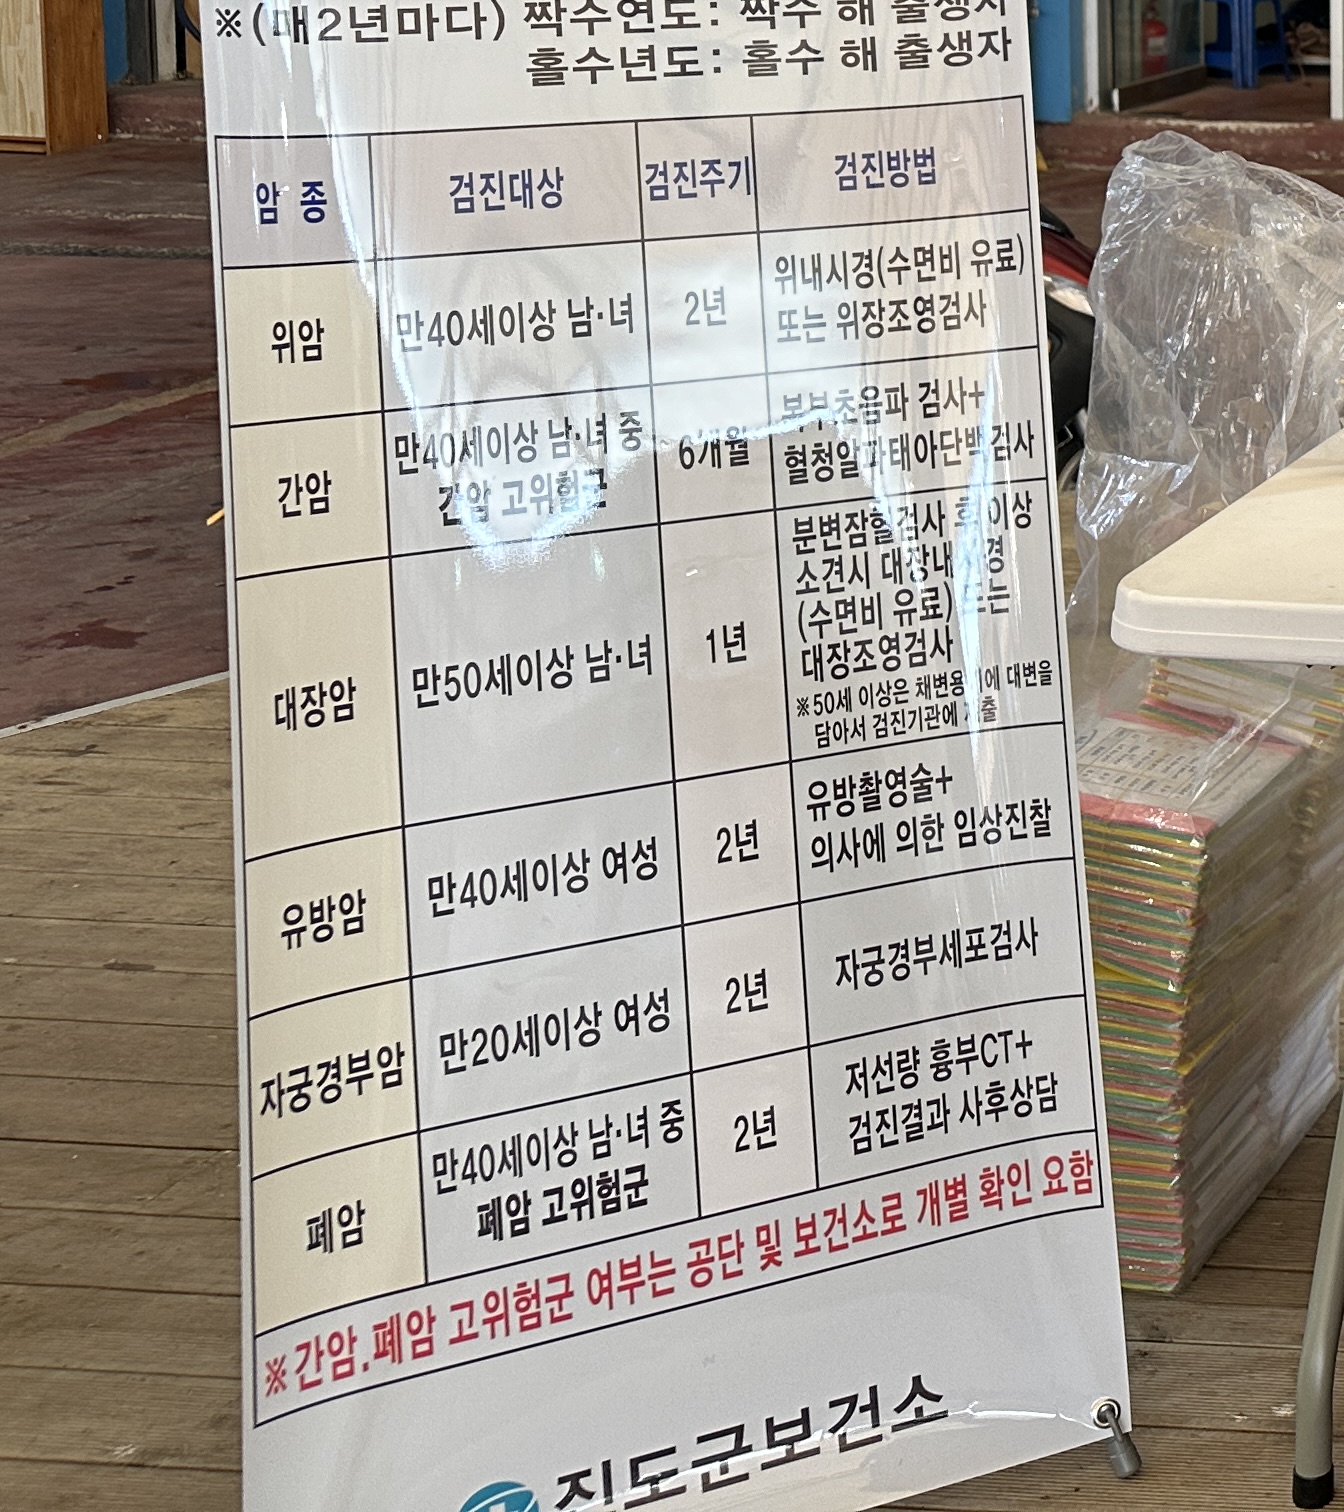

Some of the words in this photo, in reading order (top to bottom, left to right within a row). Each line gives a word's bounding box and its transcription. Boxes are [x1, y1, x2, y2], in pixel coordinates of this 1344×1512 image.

[525, 44, 722, 87] 홀수년도:
[741, 39, 824, 78] 홀수
[839, 34, 879, 74] 해
[893, 26, 1012, 71] 출생자
[449, 166, 564, 214] 검진대상
[645, 156, 752, 201] 검진주기
[834, 146, 937, 192] 검진방법
[774, 241, 961, 296] 위내시경(수면비
[971, 233, 1025, 277] 유료)
[397, 299, 557, 353] 만40세이상
[685, 286, 728, 327] 2년
[777, 305, 827, 344] 또는
[836, 289, 987, 340] 위장조영검사
[271, 318, 325, 364] 위암
[918, 376, 986, 419] 검사+
[394, 422, 538, 476] 만40세이상
[619, 410, 643, 451] 중
[679, 425, 750, 469] 6개월
[278, 469, 332, 518] 간암
[438, 481, 491, 526] 간암
[988, 489, 1032, 530] 이상
[796, 551, 870, 596] 소견시
[882, 535, 1006, 584] 대장내경
[799, 591, 883, 643] (수면비
[893, 584, 953, 626] 유료)
[706, 621, 748, 664] 1년
[801, 625, 954, 682] 대장조영검사
[274, 677, 357, 733] 대장암
[413, 645, 574, 709] 만50세이상
[859, 678, 909, 709] 이상은
[1007, 660, 1053, 688] 대변을
[815, 715, 867, 748] 담아서
[872, 700, 958, 737] 검진기관에
[806, 762, 953, 822] 유방촬영술+
[717, 819, 760, 864] 2년
[810, 822, 887, 873] 의사에
[896, 812, 945, 858] 의한
[953, 797, 1052, 849] 임상진찰
[427, 849, 591, 918] 만40세이상
[602, 836, 659, 885] 여성
[281, 889, 366, 950] 유방암
[835, 916, 1039, 990] 자궁경부세포검사
[725, 968, 769, 1015] 2년
[439, 1001, 602, 1076] 만20세이상
[614, 987, 672, 1037] 여성
[260, 1041, 406, 1119] 자궁경부암
[845, 1045, 920, 1099] 저선량
[929, 1029, 1034, 1082] 흉부CT+
[733, 1104, 778, 1153] 2년
[849, 1092, 951, 1156] 검진결과
[958, 1072, 1058, 1127] 사후상담
[432, 1121, 579, 1195] 만40세이상
[659, 1098, 685, 1145] 중
[306, 1200, 366, 1255] 폐암
[477, 1190, 532, 1242] 폐암
[541, 1163, 650, 1227] 고위험군
[448, 1272, 574, 1346] 고위험군
[586, 1250, 676, 1311] 여부는
[686, 1229, 745, 1289] 공단
[755, 1219, 784, 1273] 및
[793, 1192, 908, 1260] 보건소로
[916, 1172, 970, 1228] 개별
[978, 1158, 1033, 1212] 확인
[1043, 1149, 1095, 1198] 요함
[554, 1374, 949, 1511] 진도군보건소
